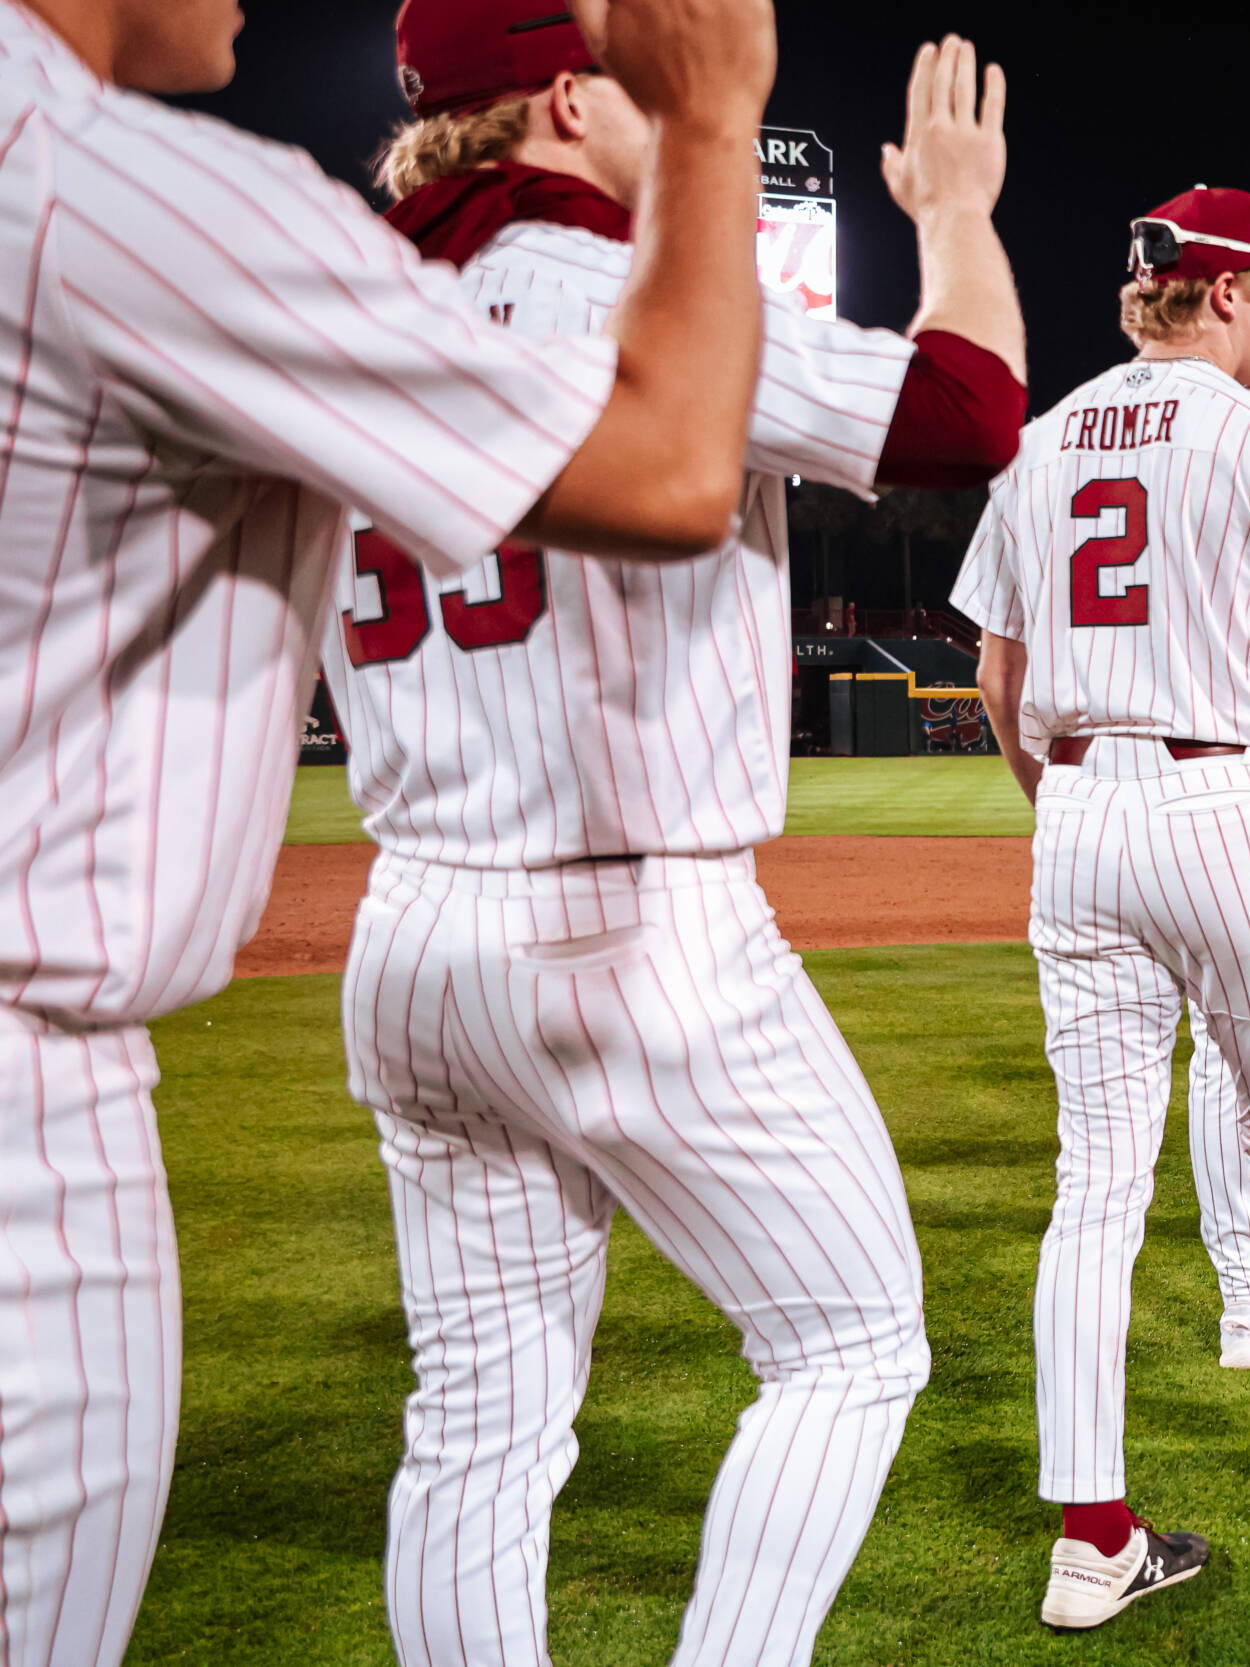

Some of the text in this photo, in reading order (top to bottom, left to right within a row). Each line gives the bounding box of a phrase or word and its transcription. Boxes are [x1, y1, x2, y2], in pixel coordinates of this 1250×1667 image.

[1061, 399, 1180, 451] CROMER
[1070, 476, 1149, 628] 2
[1062, 1569, 1112, 1588] ARMOUR
